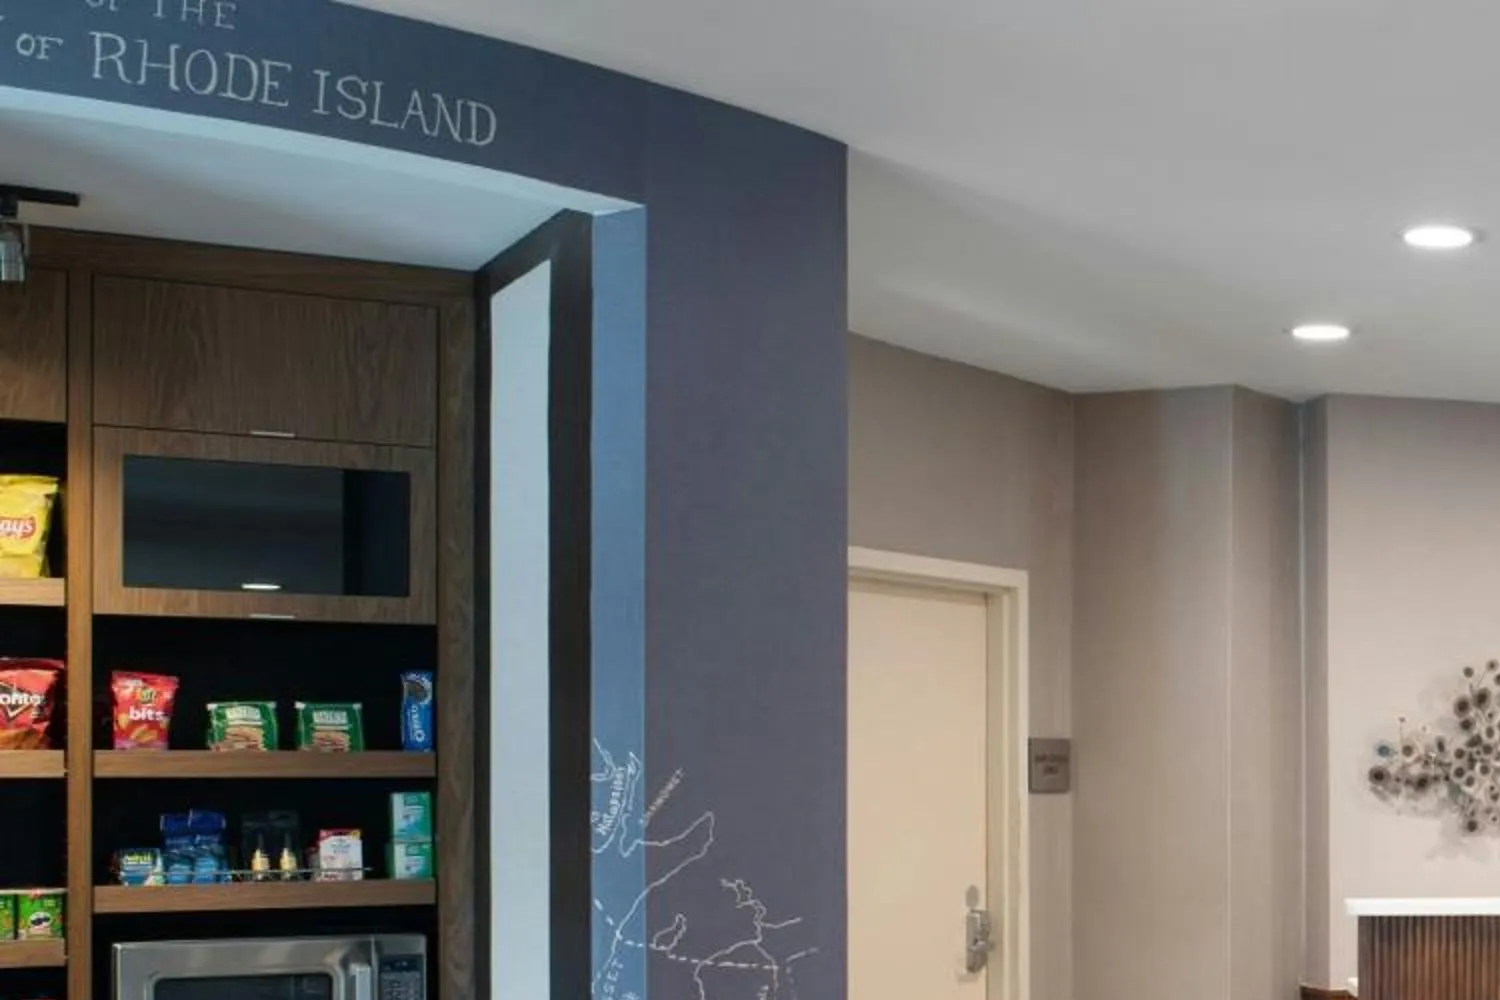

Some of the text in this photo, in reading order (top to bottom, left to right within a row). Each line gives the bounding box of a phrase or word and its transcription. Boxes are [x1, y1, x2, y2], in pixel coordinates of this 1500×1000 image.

[153, 0, 237, 29] THE
[16, 31, 497, 146] OF RHODE ISLAND
[129, 704, 166, 721] bits
